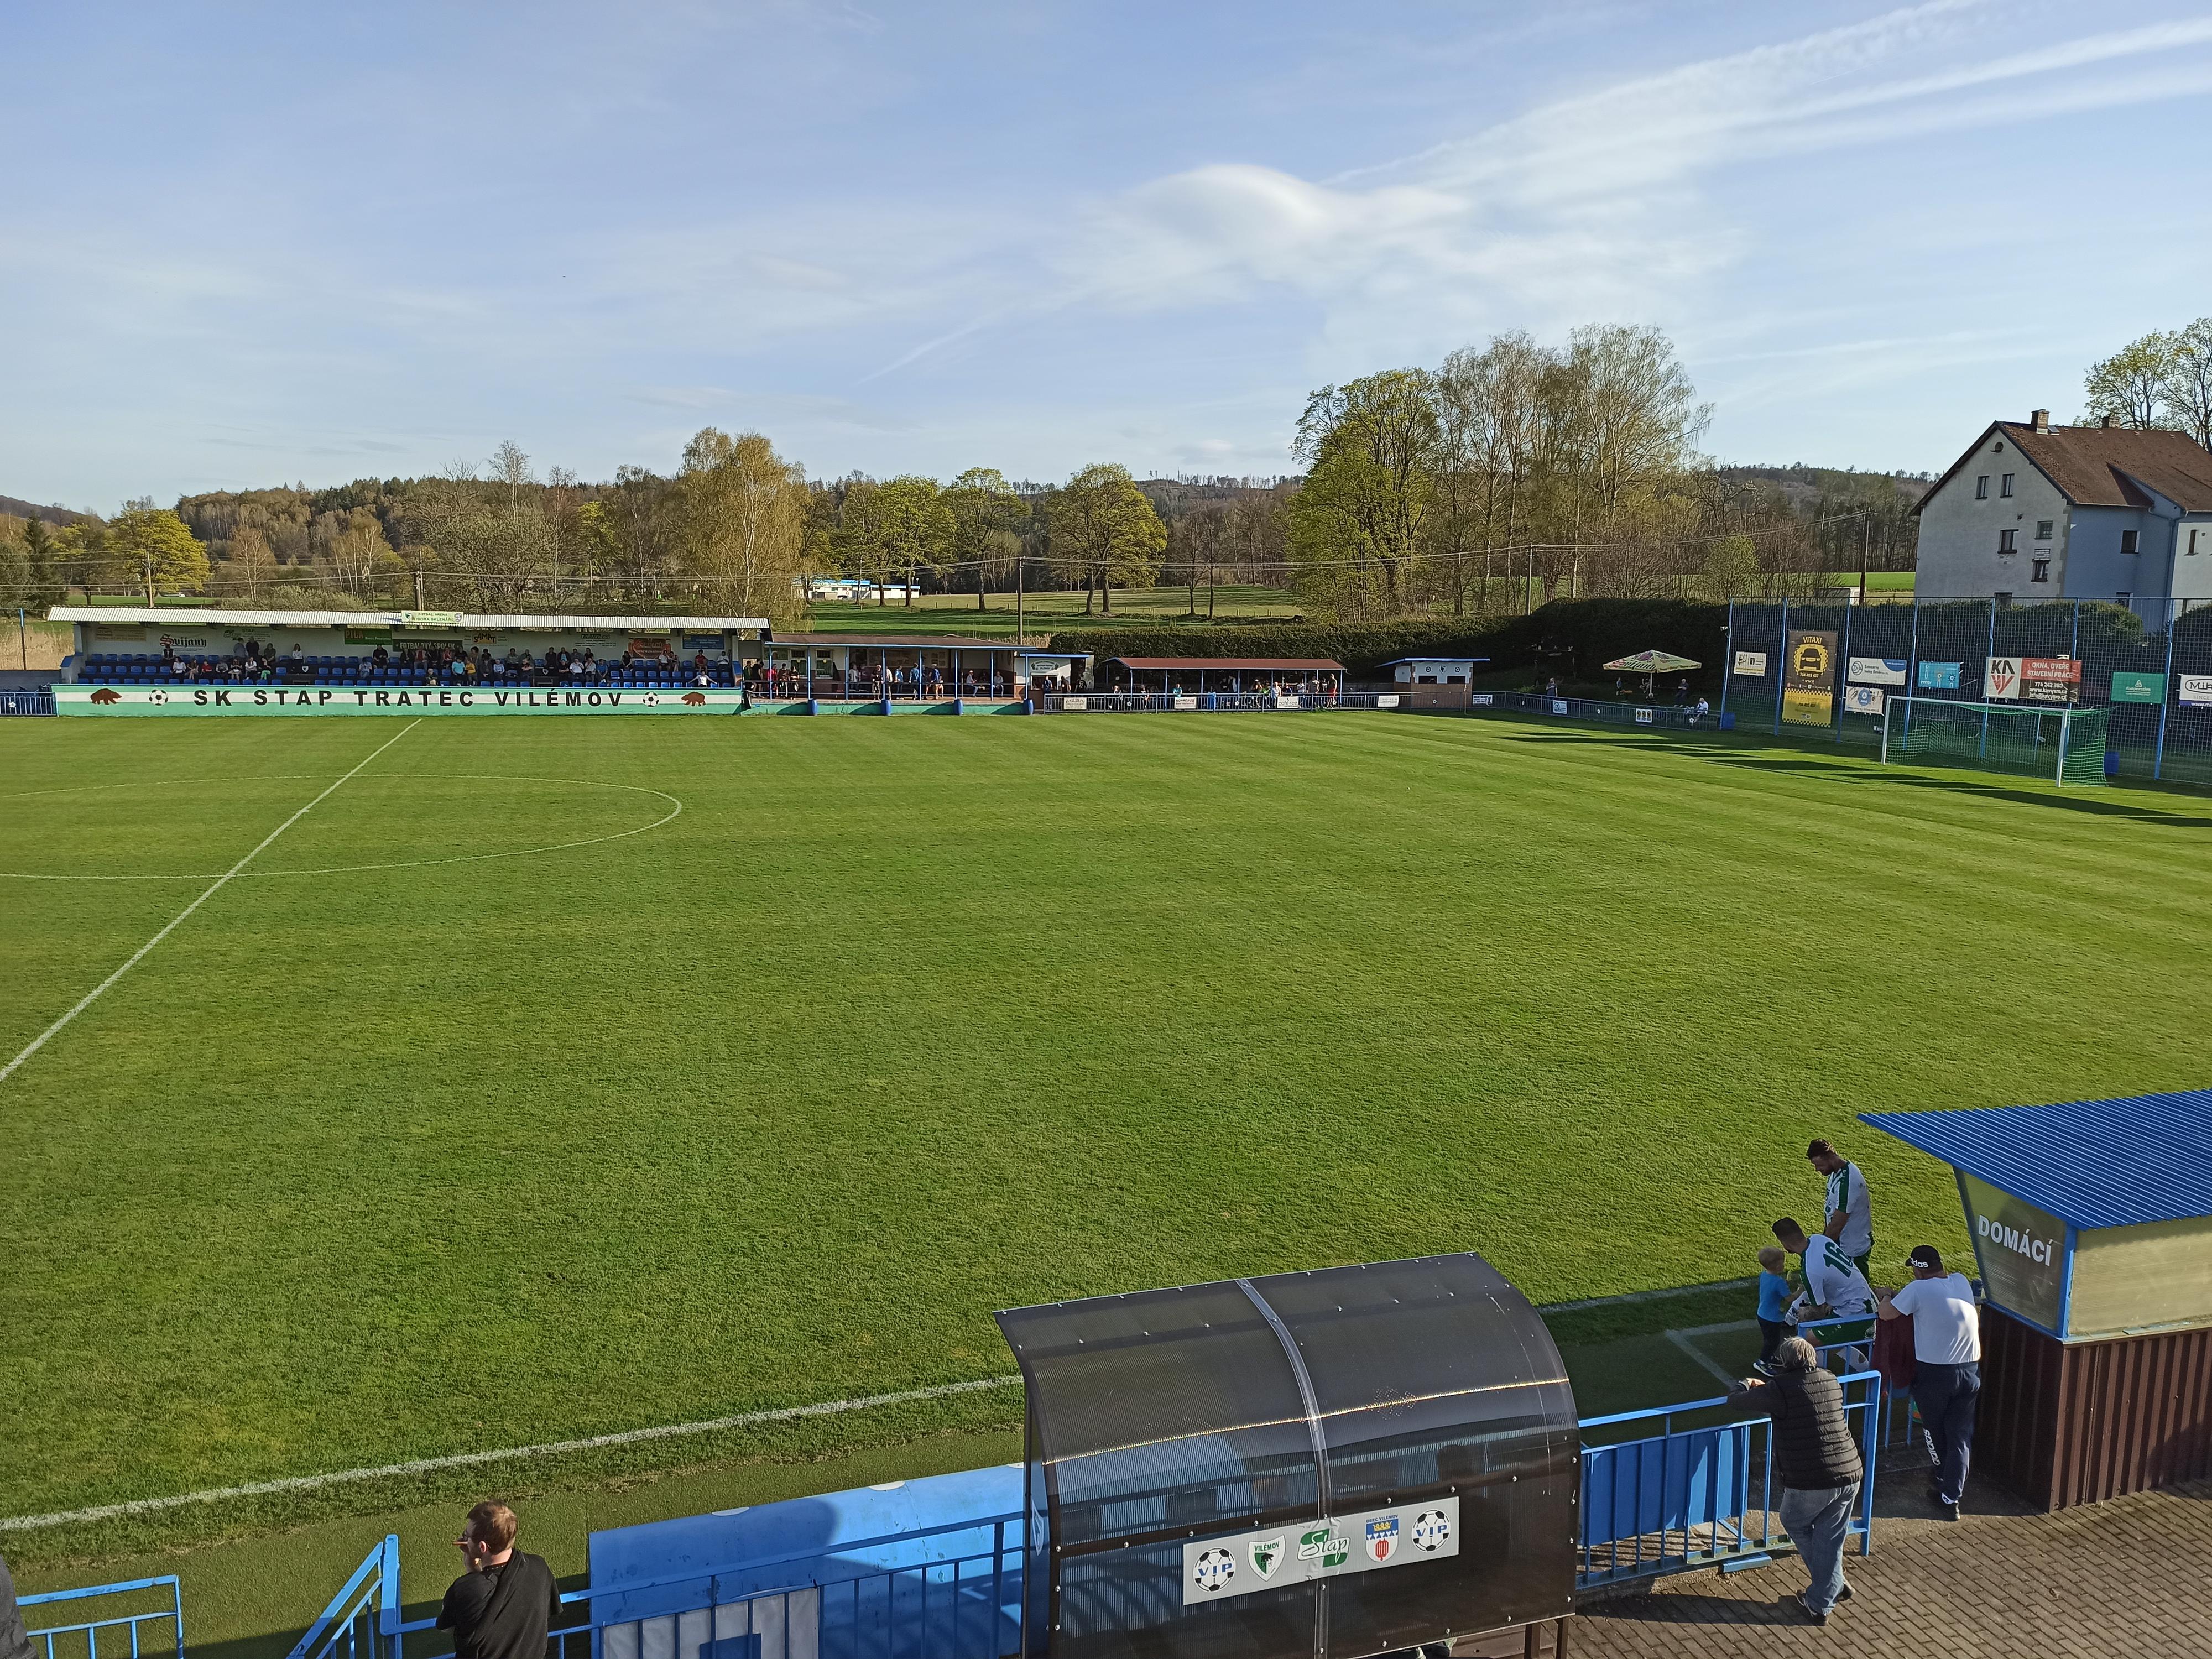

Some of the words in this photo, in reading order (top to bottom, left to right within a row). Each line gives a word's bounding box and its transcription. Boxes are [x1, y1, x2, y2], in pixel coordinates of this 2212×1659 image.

[160, 634, 207, 648] Svijany
[345, 630, 363, 639] PILA
[474, 633, 495, 643] SAMAT
[1803, 636, 1822, 644] VITAXI
[194, 690, 232, 706] SK
[254, 690, 332, 706] STAP
[353, 690, 473, 707] TRATEC
[494, 688, 622, 707] VILÉMOV
[1978, 1214, 2054, 1266] DOMÁCÍ
[1824, 1240, 1851, 1279] 16
[1923, 1428, 1941, 1465] adidas
[1416, 1525, 1447, 1537] VIP
[1254, 1541, 1280, 1552] VILÉMOV
[1302, 1531, 1347, 1563] Stap
[1198, 1563, 1232, 1576] VIP
